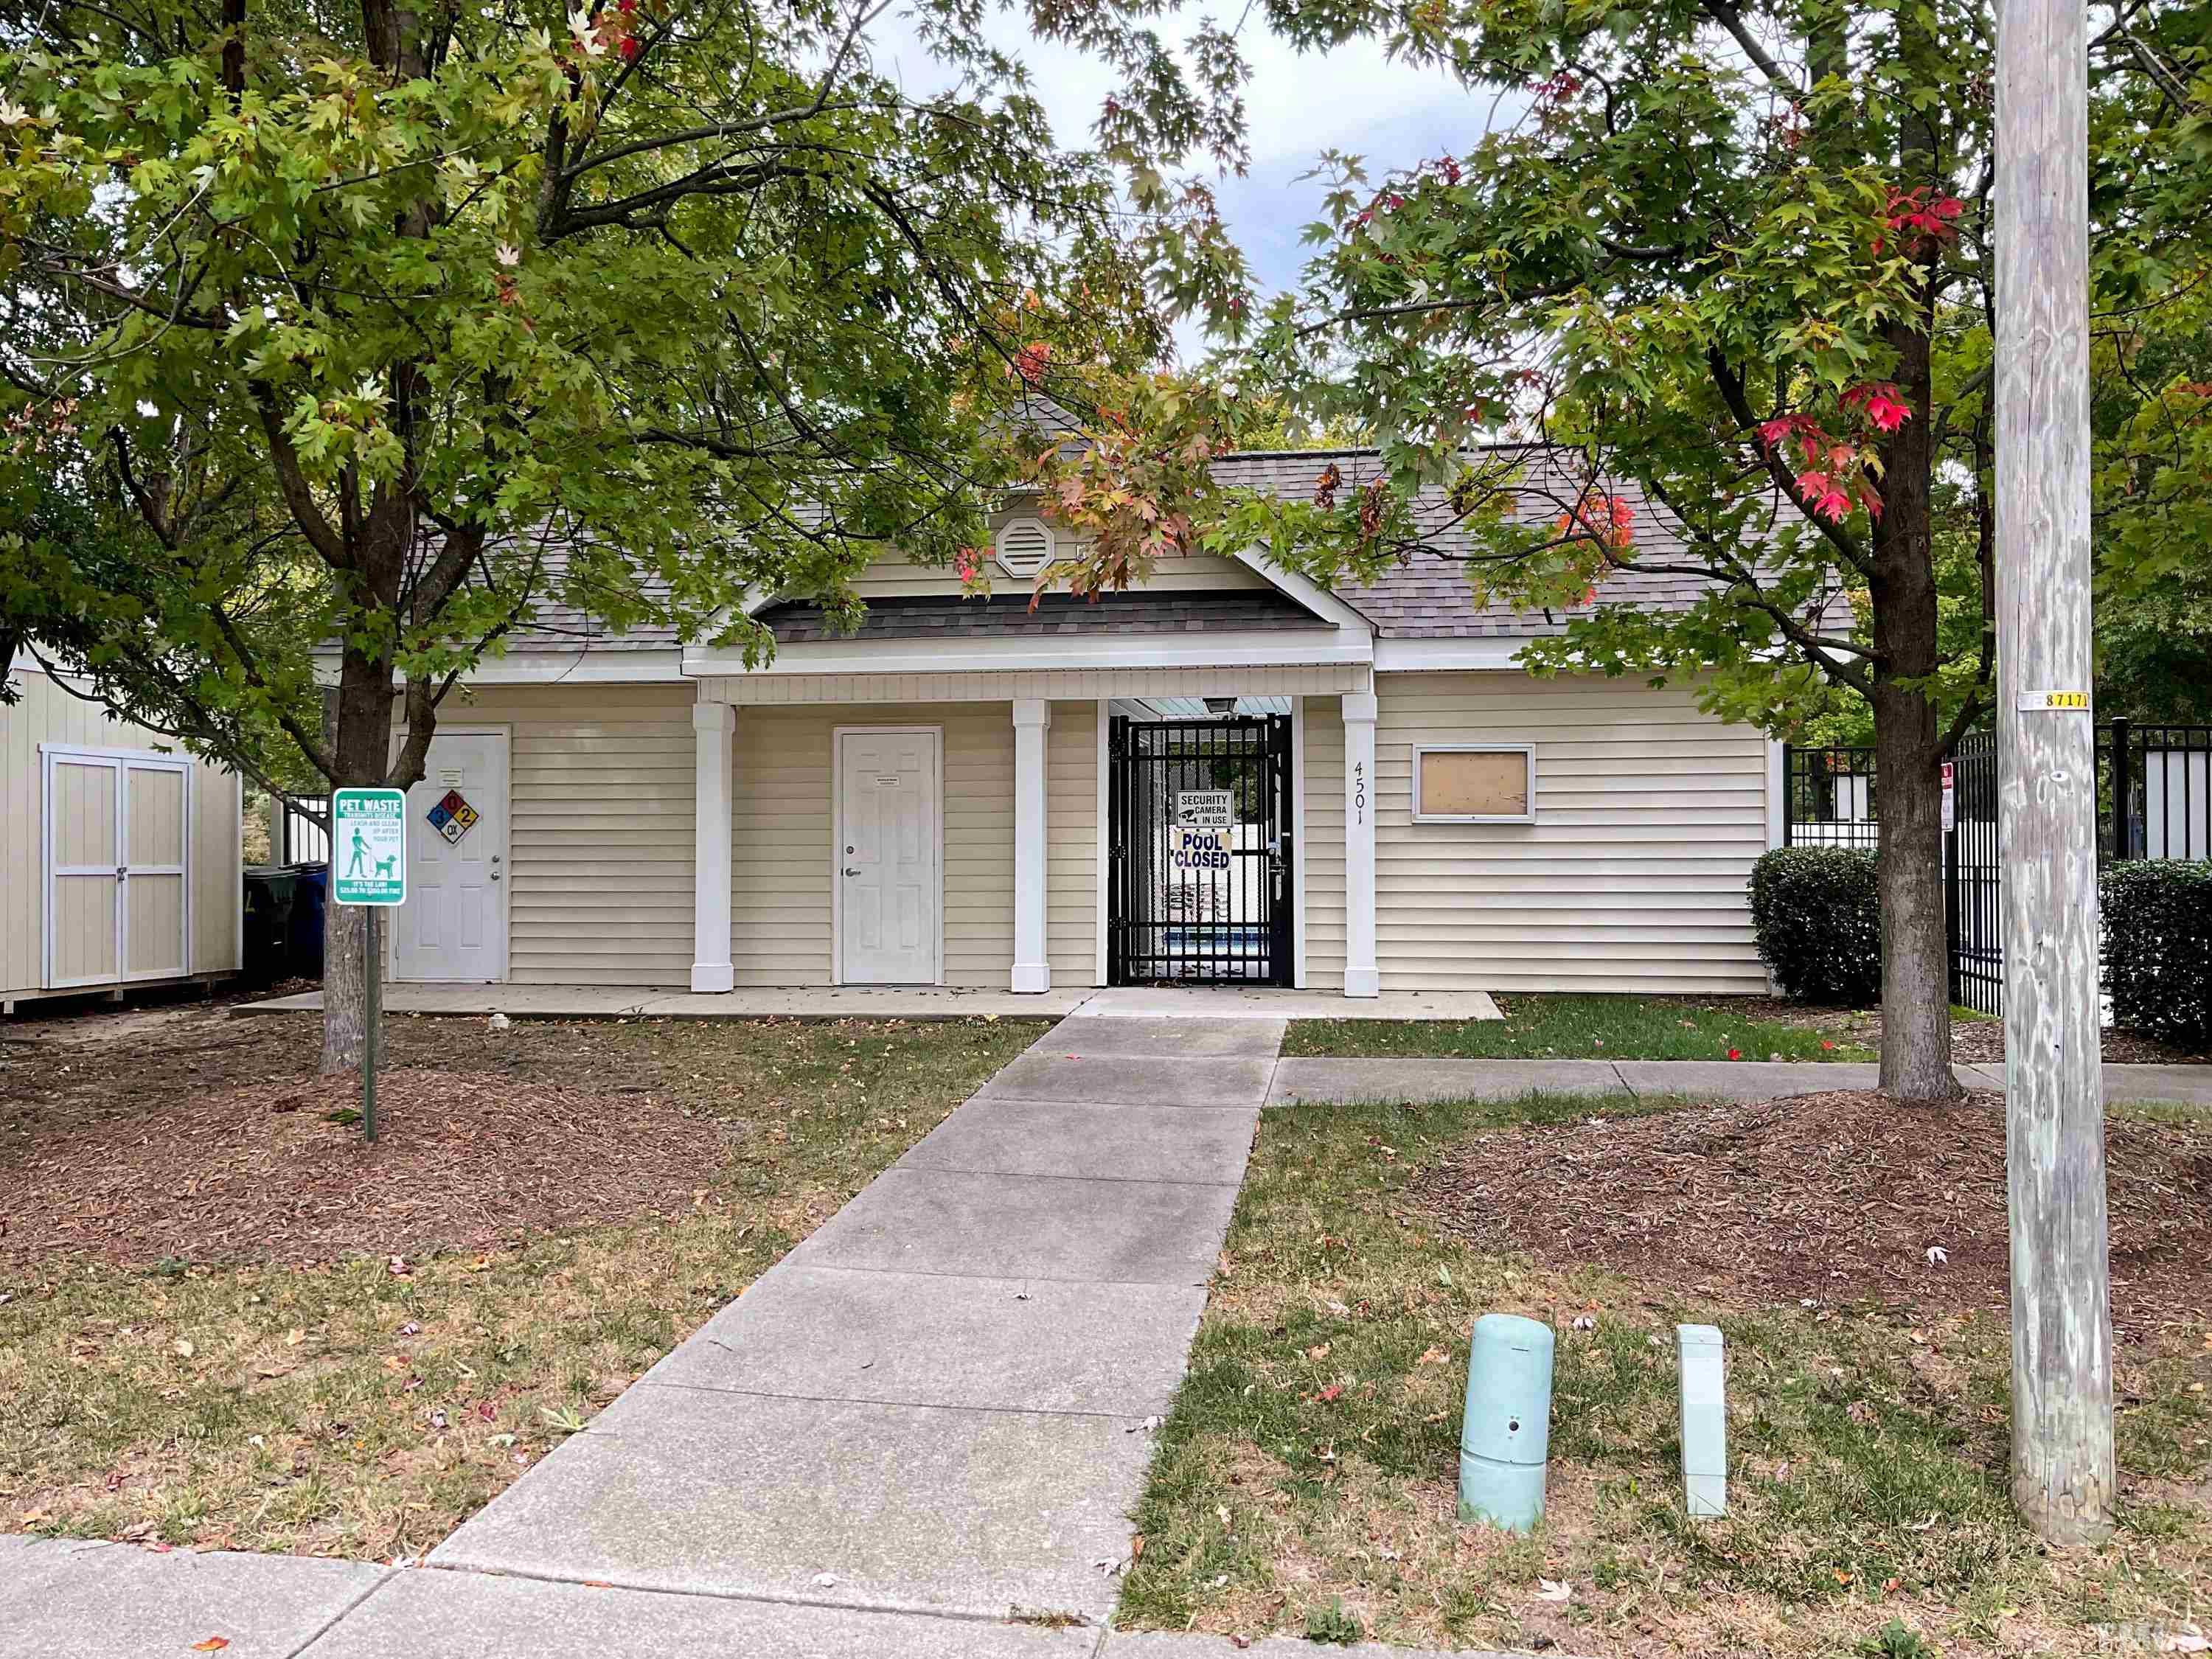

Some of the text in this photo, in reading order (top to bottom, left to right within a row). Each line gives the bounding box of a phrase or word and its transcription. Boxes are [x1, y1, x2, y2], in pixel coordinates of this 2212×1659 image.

[1181, 796, 1228, 805] SECURITY
[1354, 762, 1365, 825] 4501
[340, 799, 400, 812] PET WASTE
[448, 796, 458, 810] 0
[436, 810, 445, 824] 3
[461, 809, 471, 823] 2
[447, 825, 458, 835] OX
[1183, 834, 1222, 850] POOL
[1175, 850, 1229, 868] CLOSED
